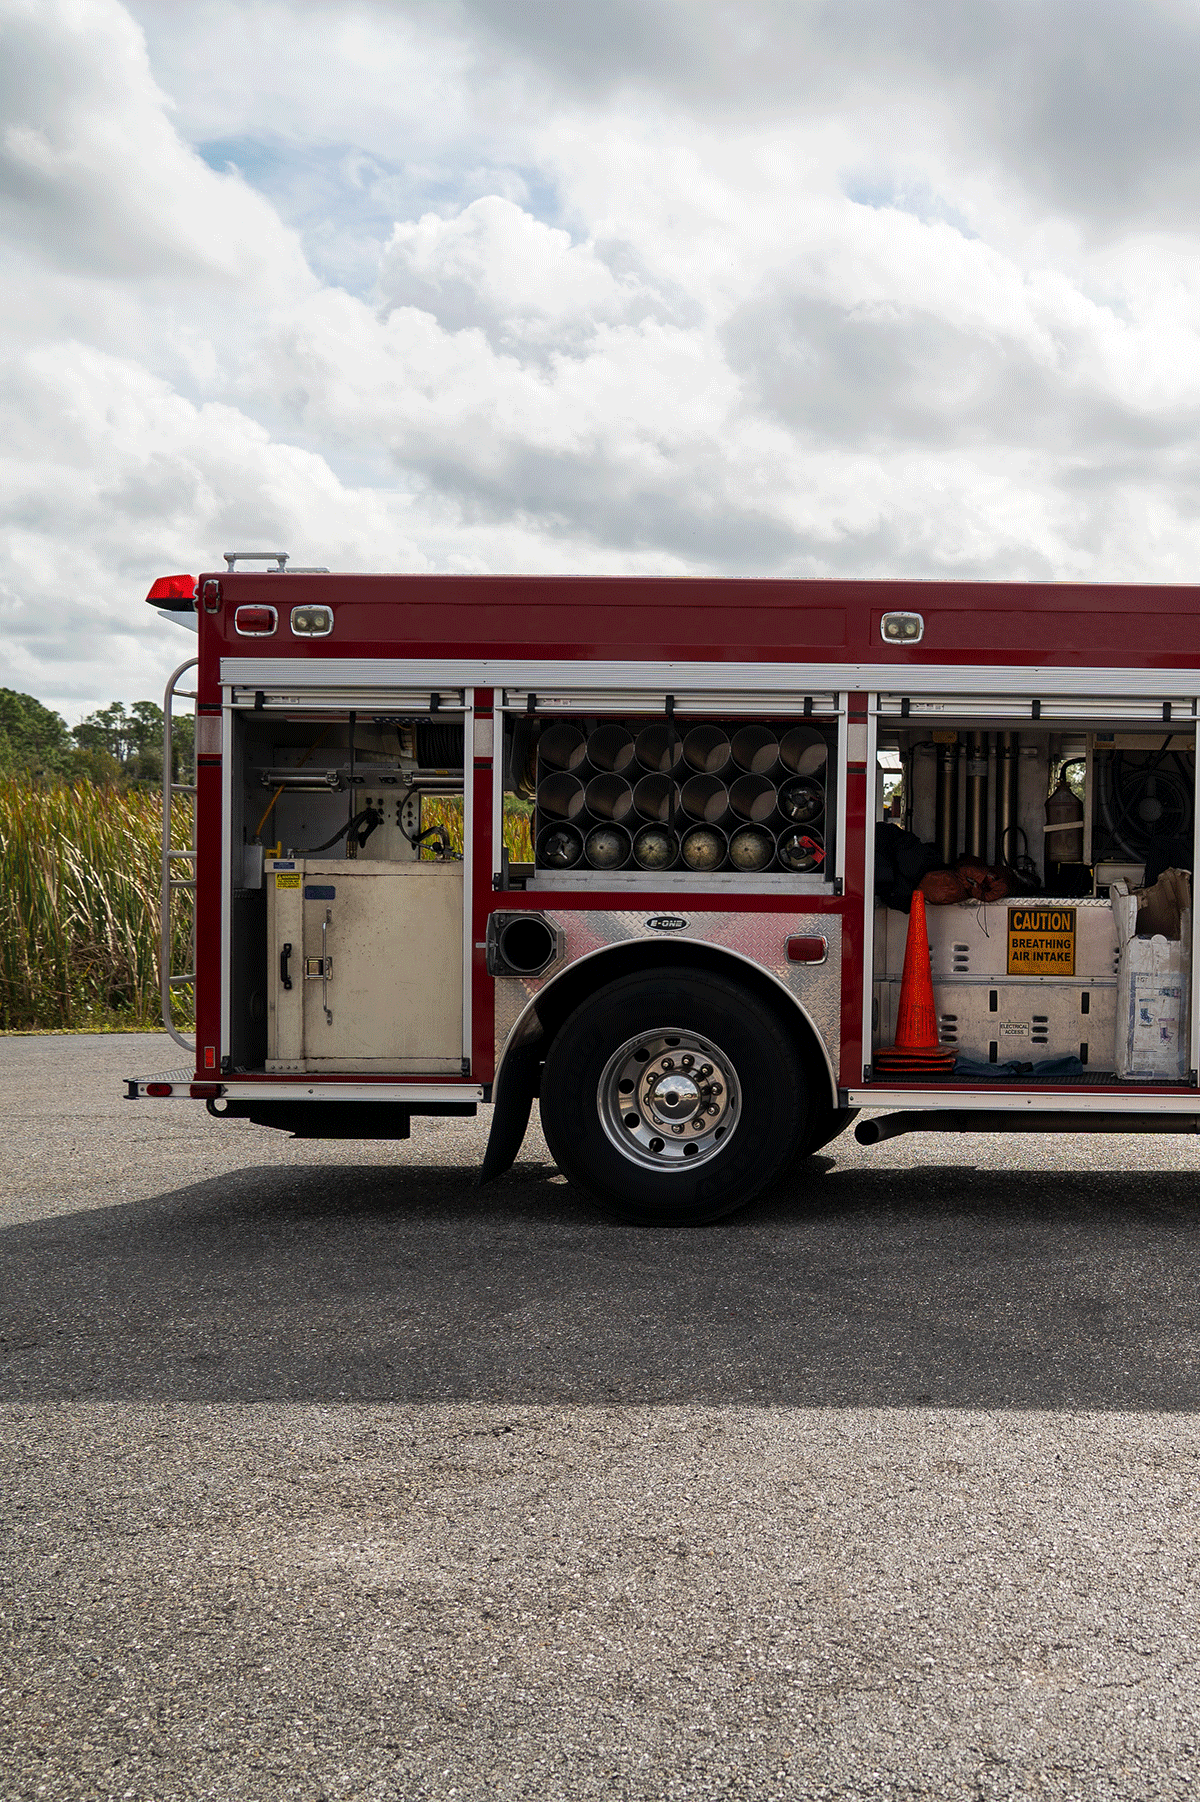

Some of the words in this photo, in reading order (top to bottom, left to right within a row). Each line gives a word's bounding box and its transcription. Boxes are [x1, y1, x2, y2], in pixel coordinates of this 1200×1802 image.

[650, 919, 683, 927] E-ONE
[1013, 911, 1071, 930] CAUTION
[1012, 938, 1071, 949] BREATHING
[1012, 951, 1030, 961] AIR
[1033, 951, 1071, 962] INTAKE
